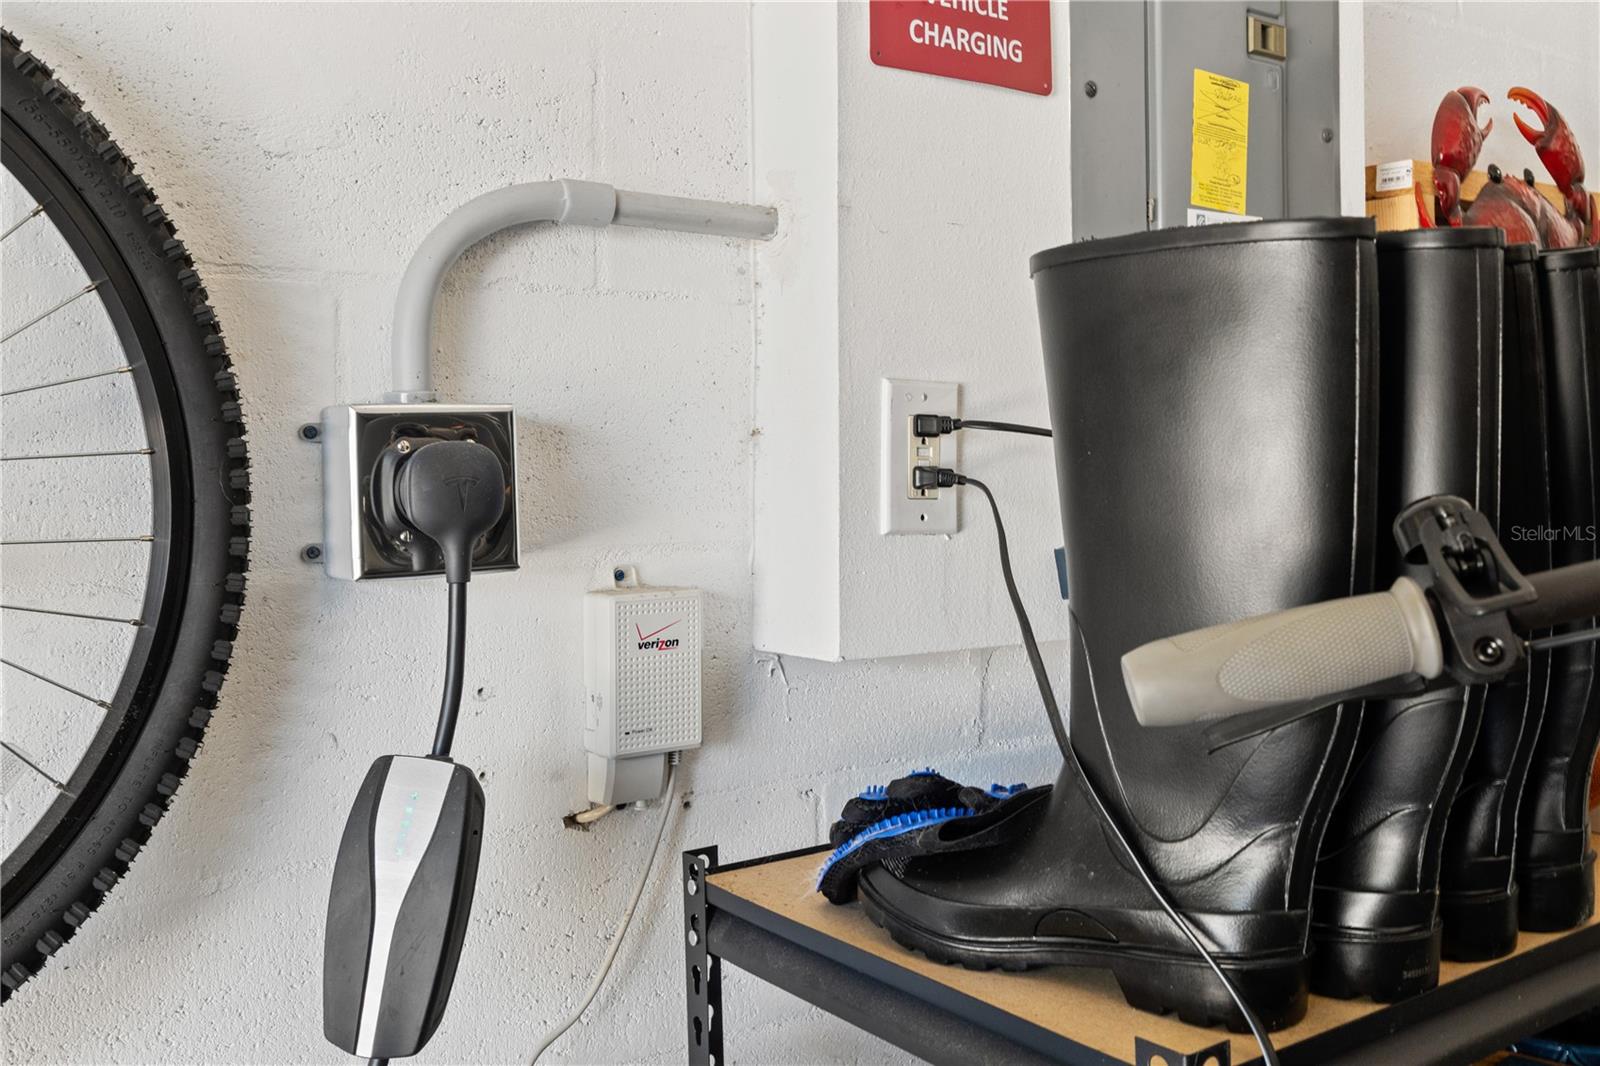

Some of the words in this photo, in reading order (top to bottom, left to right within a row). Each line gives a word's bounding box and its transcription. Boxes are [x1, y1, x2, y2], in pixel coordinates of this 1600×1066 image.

[927, 0, 1009, 21] ICLE
[909, 18, 1023, 63] CHARGING
[638, 638, 679, 651] verizon
